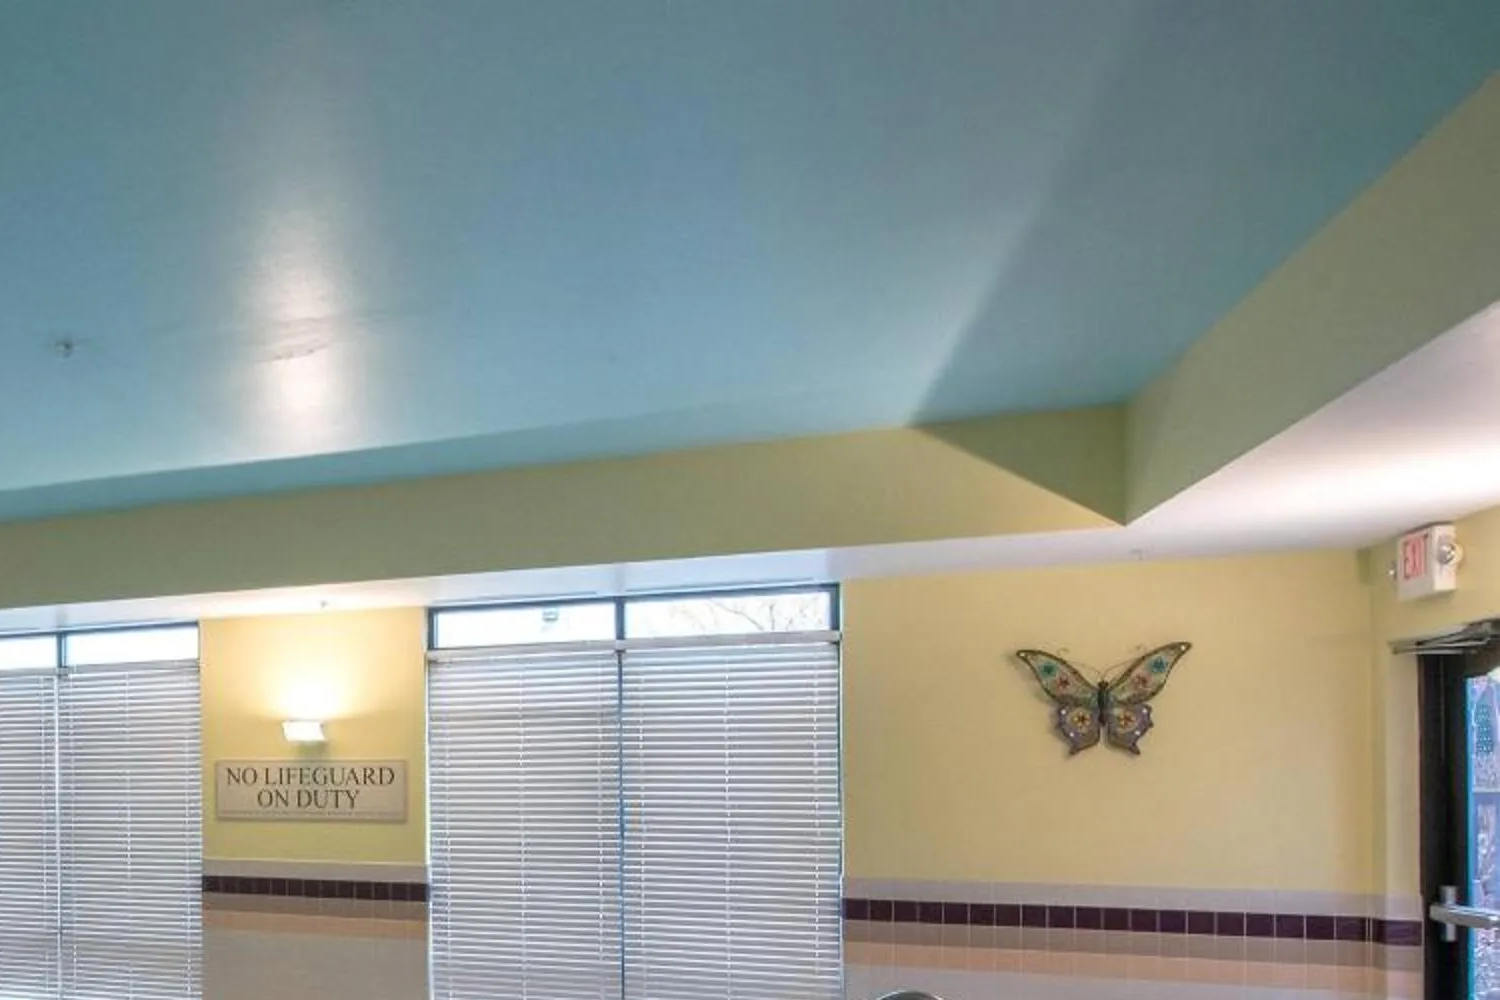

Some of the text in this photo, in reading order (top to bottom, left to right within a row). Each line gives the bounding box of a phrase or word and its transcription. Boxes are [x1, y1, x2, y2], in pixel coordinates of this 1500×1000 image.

[1403, 532, 1428, 580] EXIT
[227, 767, 395, 786] NO LIFEGUARD
[257, 789, 360, 809] ON DUTY
